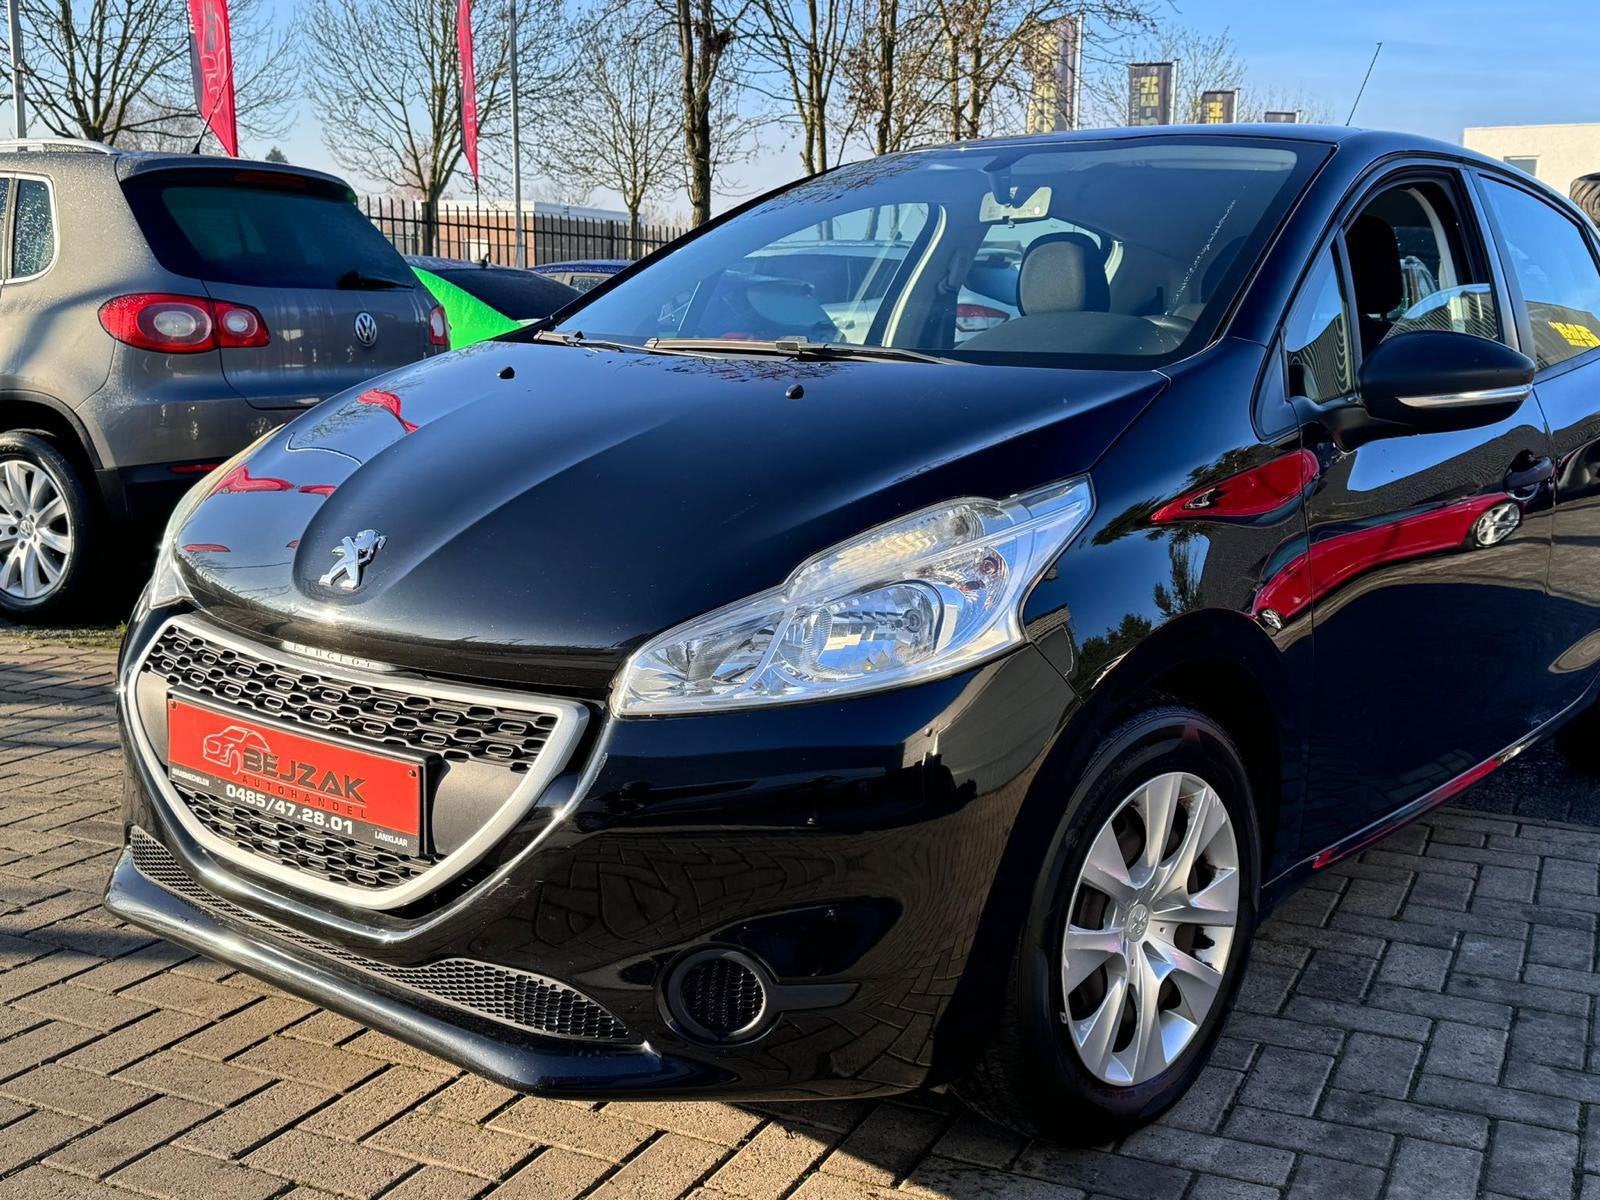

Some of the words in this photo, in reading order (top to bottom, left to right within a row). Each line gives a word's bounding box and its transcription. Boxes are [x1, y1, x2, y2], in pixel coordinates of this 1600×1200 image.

[241, 775, 369, 819] AUTOHANDEL
[242, 748, 367, 803] BEJZAK
[225, 784, 354, 835] 0485/47.28.01
